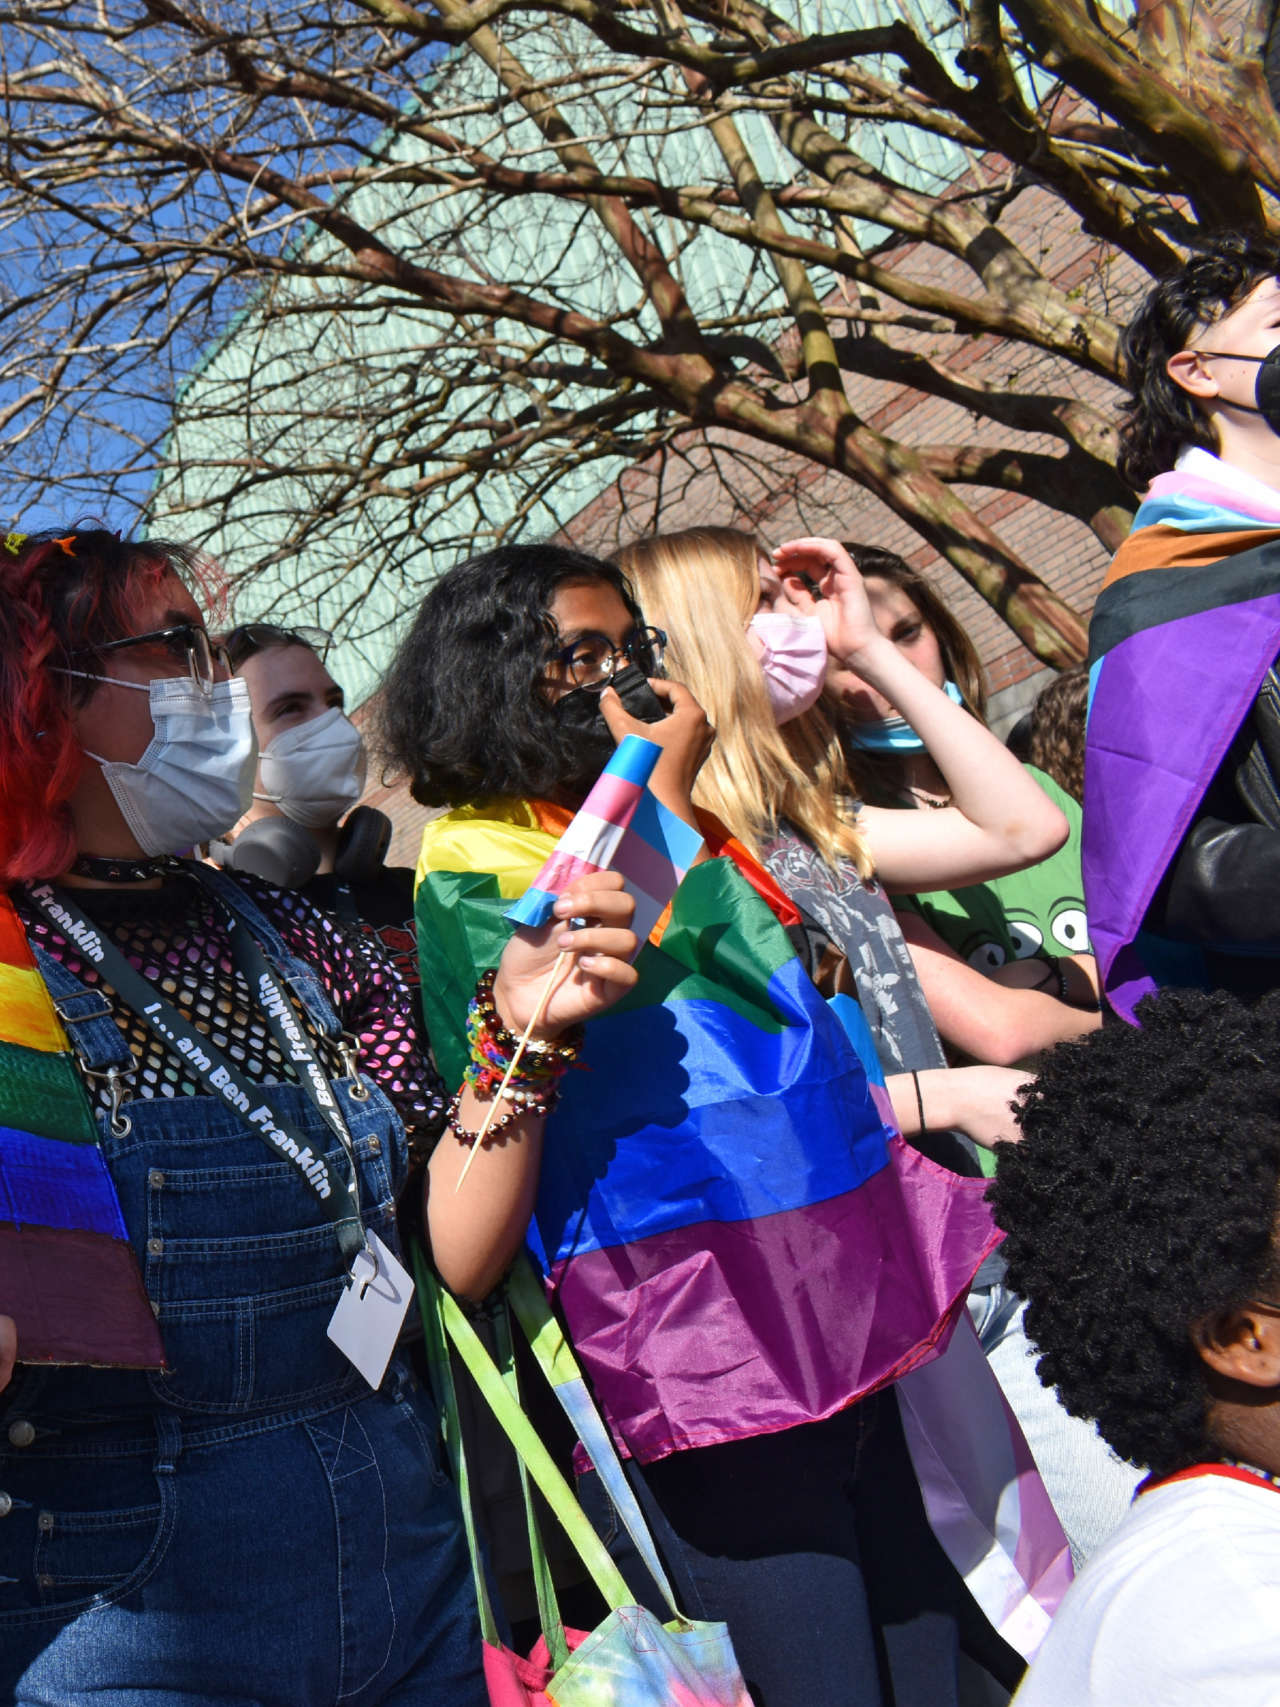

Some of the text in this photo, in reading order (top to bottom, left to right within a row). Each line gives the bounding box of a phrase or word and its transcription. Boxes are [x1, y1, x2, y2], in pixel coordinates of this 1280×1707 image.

[32, 884, 105, 963] Franklin
[258, 973, 334, 1107] Ben Franklin
[176, 1037, 212, 1072] am
[209, 1065, 250, 1113] Ben
[248, 1105, 332, 1199] Franklin
